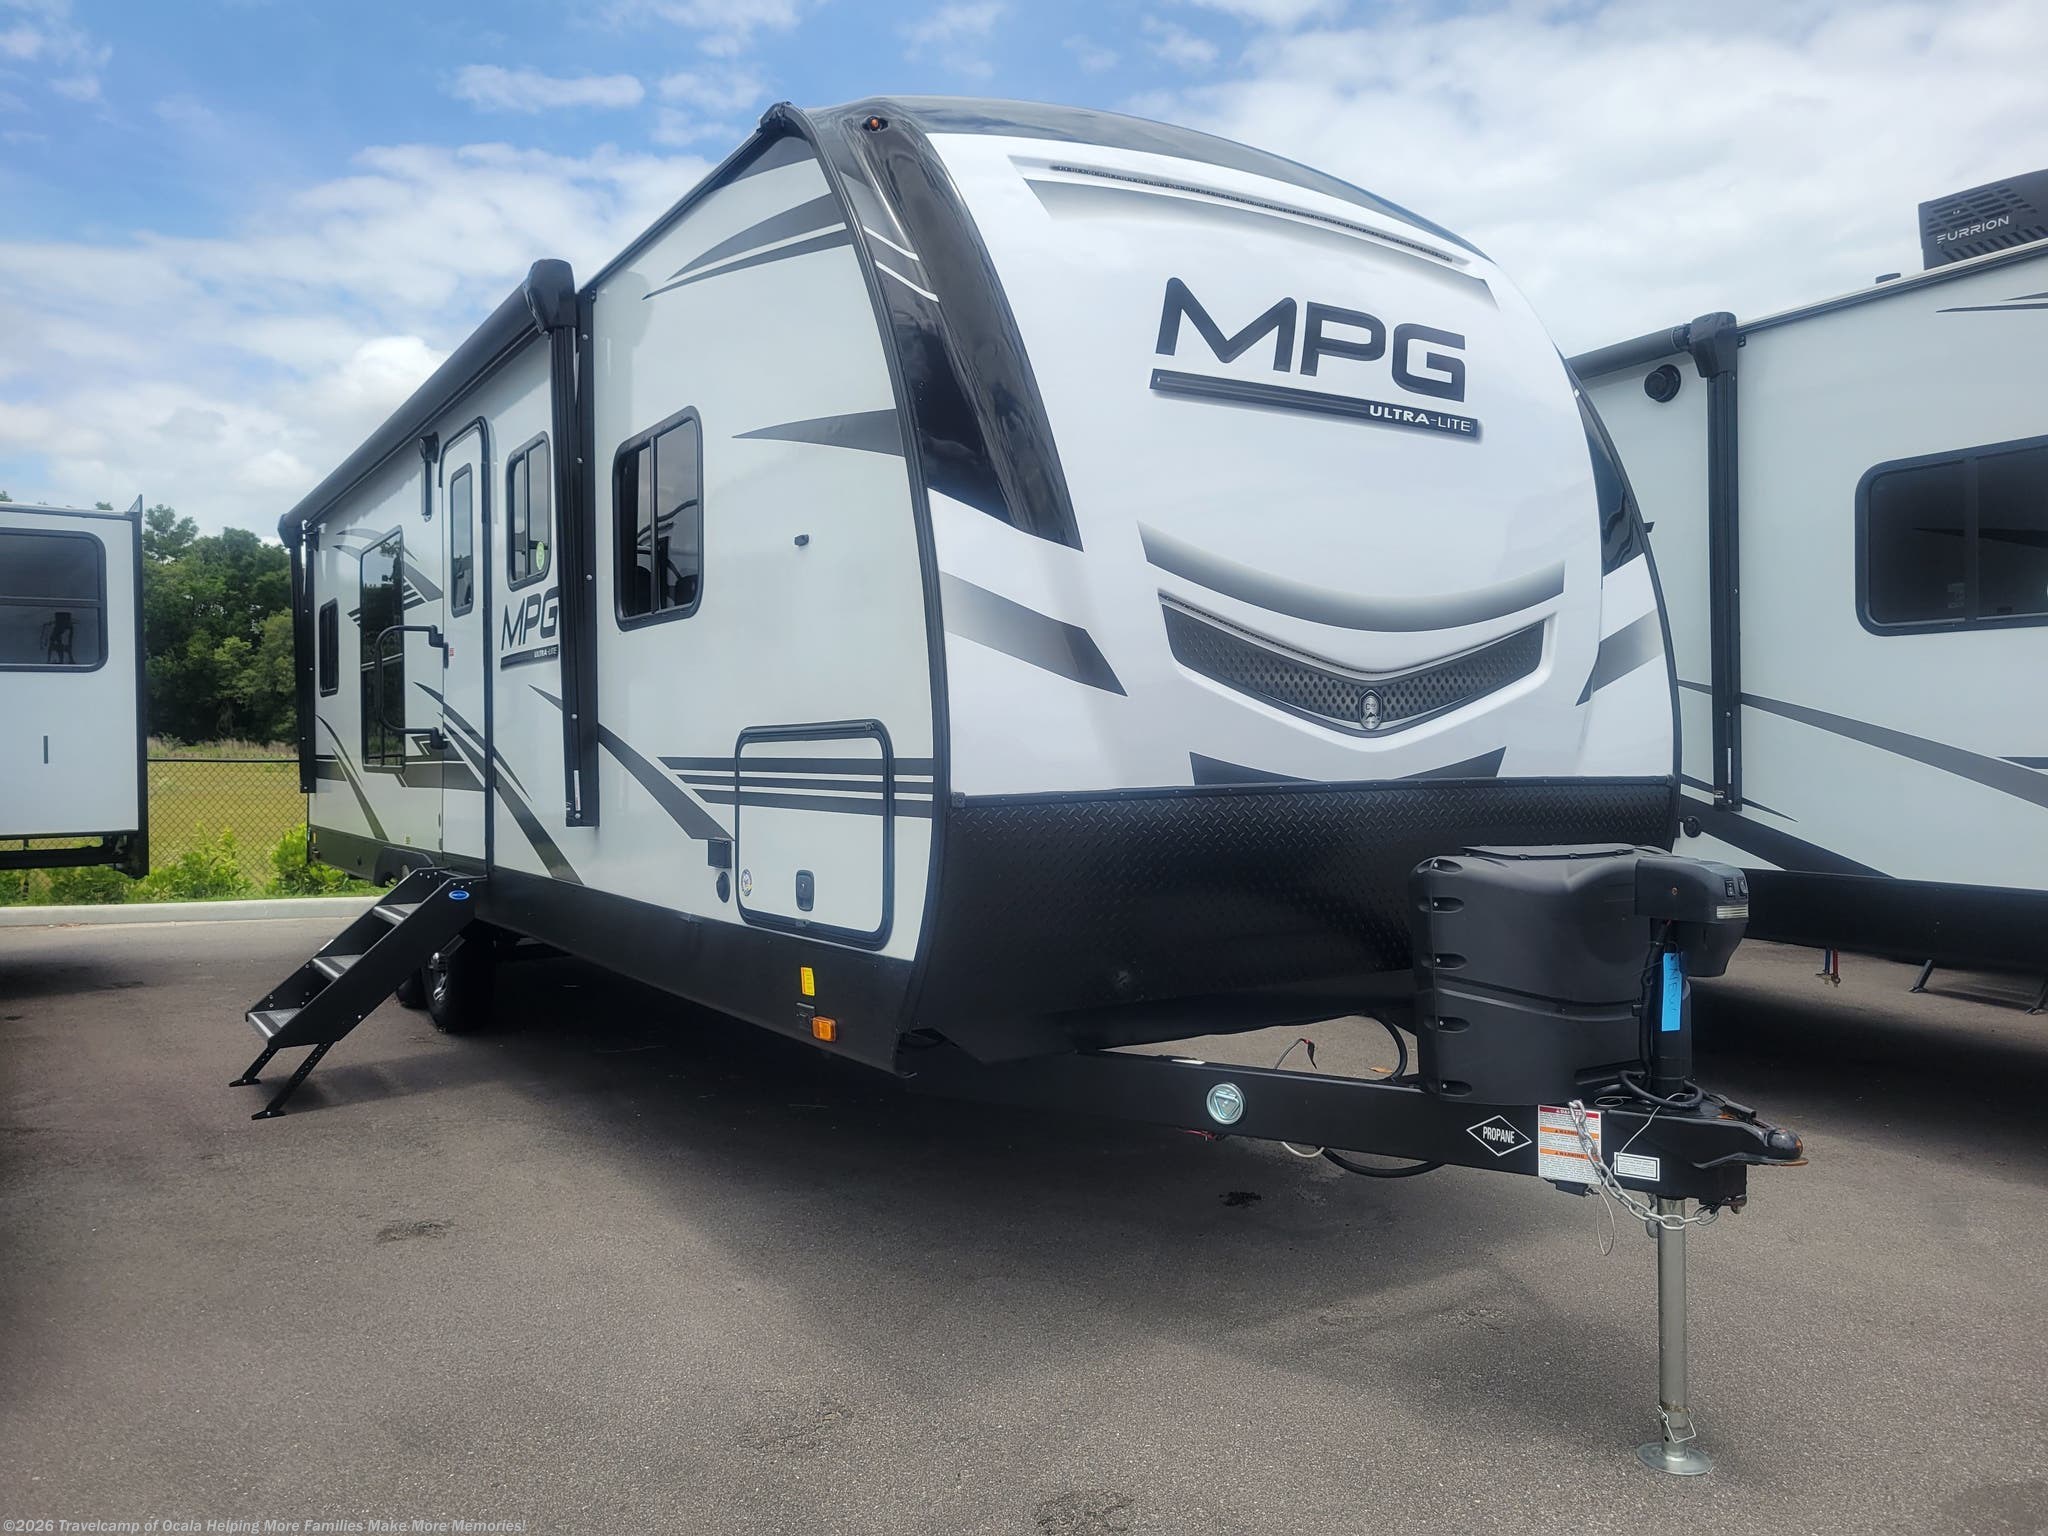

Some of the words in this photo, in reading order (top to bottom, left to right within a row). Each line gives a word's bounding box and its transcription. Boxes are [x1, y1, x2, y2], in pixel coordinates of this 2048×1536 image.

[1936, 216, 2009, 245] FURRION
[1155, 277, 1466, 402] MPG
[1369, 404, 1473, 432] ULTRA-LITE
[501, 586, 560, 651] MPG
[1482, 1126, 1515, 1144] PROPANE
